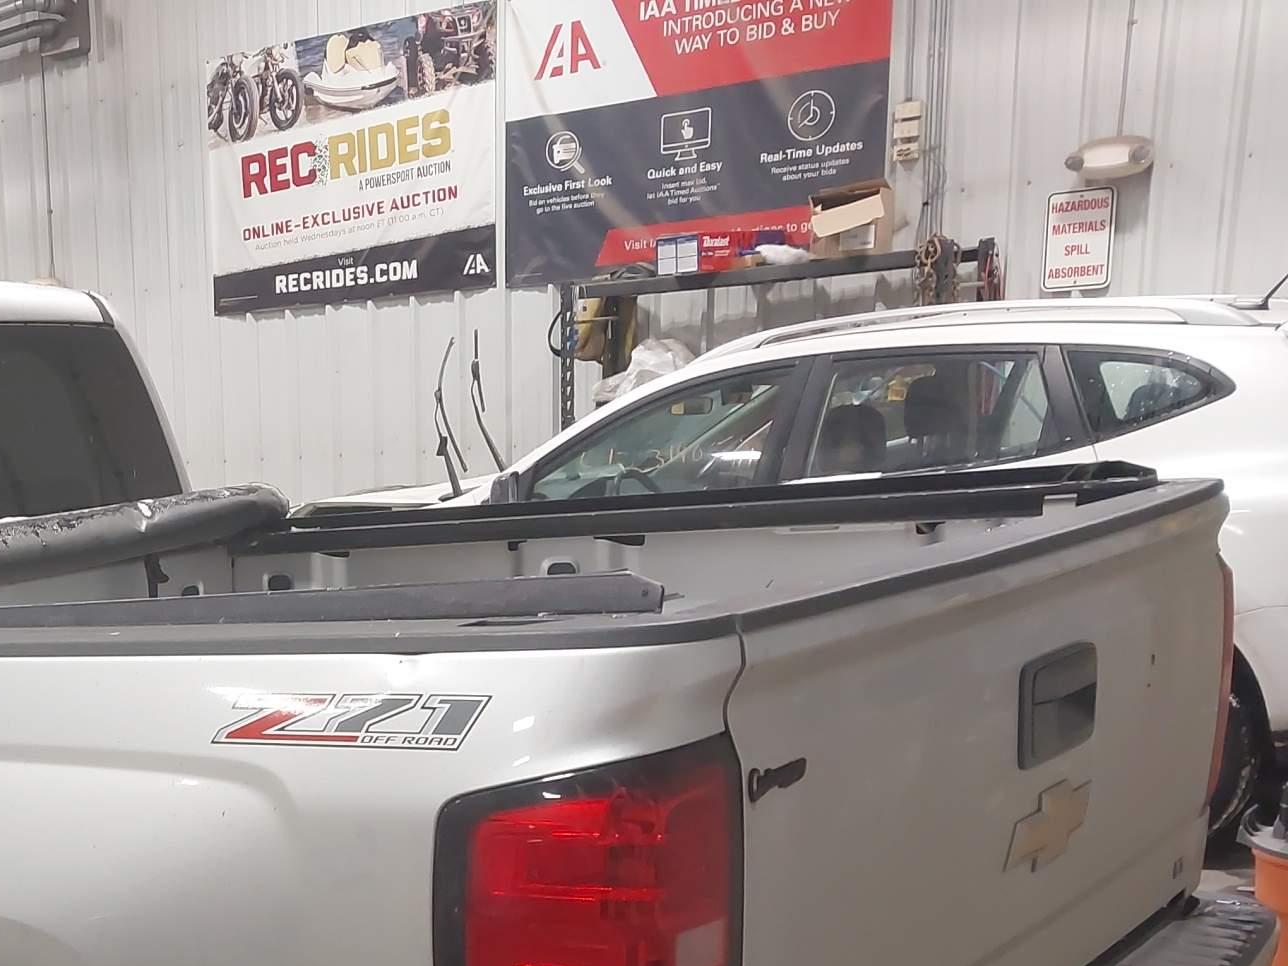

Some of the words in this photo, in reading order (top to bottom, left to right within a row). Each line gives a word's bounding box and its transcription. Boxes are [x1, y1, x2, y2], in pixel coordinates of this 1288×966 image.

[640, 0, 676, 21] IAA
[663, 0, 784, 37] INTRODUCING
[790, 0, 804, 13] A
[675, 33, 712, 55] WAY
[717, 28, 740, 47] TO
[746, 22, 775, 42] BID
[781, 18, 795, 36] &
[801, 9, 840, 32] BUY
[240, 141, 318, 199] REC
[328, 108, 452, 181] RIDES
[760, 149, 813, 164] Real-Time
[816, 141, 863, 156] Updates
[647, 166, 677, 180] Quick
[679, 164, 697, 175] and
[699, 161, 723, 173] Easy
[771, 165, 797, 174] Receive
[798, 162, 819, 171] status
[821, 158, 850, 169] updates
[365, 167, 414, 190] POWERSPORT
[417, 160, 451, 179] AUCTION
[782, 173, 802, 181] about
[803, 171, 820, 180] your
[523, 183, 563, 197] Exclusive
[564, 179, 585, 191] First
[588, 175, 613, 188] Look
[657, 190, 669, 199] IAA
[670, 187, 690, 196] Timed
[547, 195, 570, 205] vehicles
[571, 193, 590, 202] before
[551, 204, 561, 212] the
[574, 200, 595, 209] auction
[1052, 197, 1110, 214] HAZARDOUS
[242, 200, 385, 241] ONLINE-EXCLUSIVE
[390, 185, 458, 213] AUCTION
[786, 223, 798, 233] to
[1052, 219, 1106, 236] MATERIALS
[255, 238, 282, 251] Auction
[300, 228, 347, 243] Wednesdays
[357, 222, 375, 232] noon
[624, 239, 647, 251] Visit
[1064, 243, 1090, 256] SPILL
[337, 256, 354, 266] Visit
[274, 259, 419, 294] RECRIDES.COM
[1047, 264, 1105, 280] ABSORBENT
[211, 693, 492, 750] Z71
[361, 735, 399, 745] OFF
[401, 736, 458, 747] ROAD
